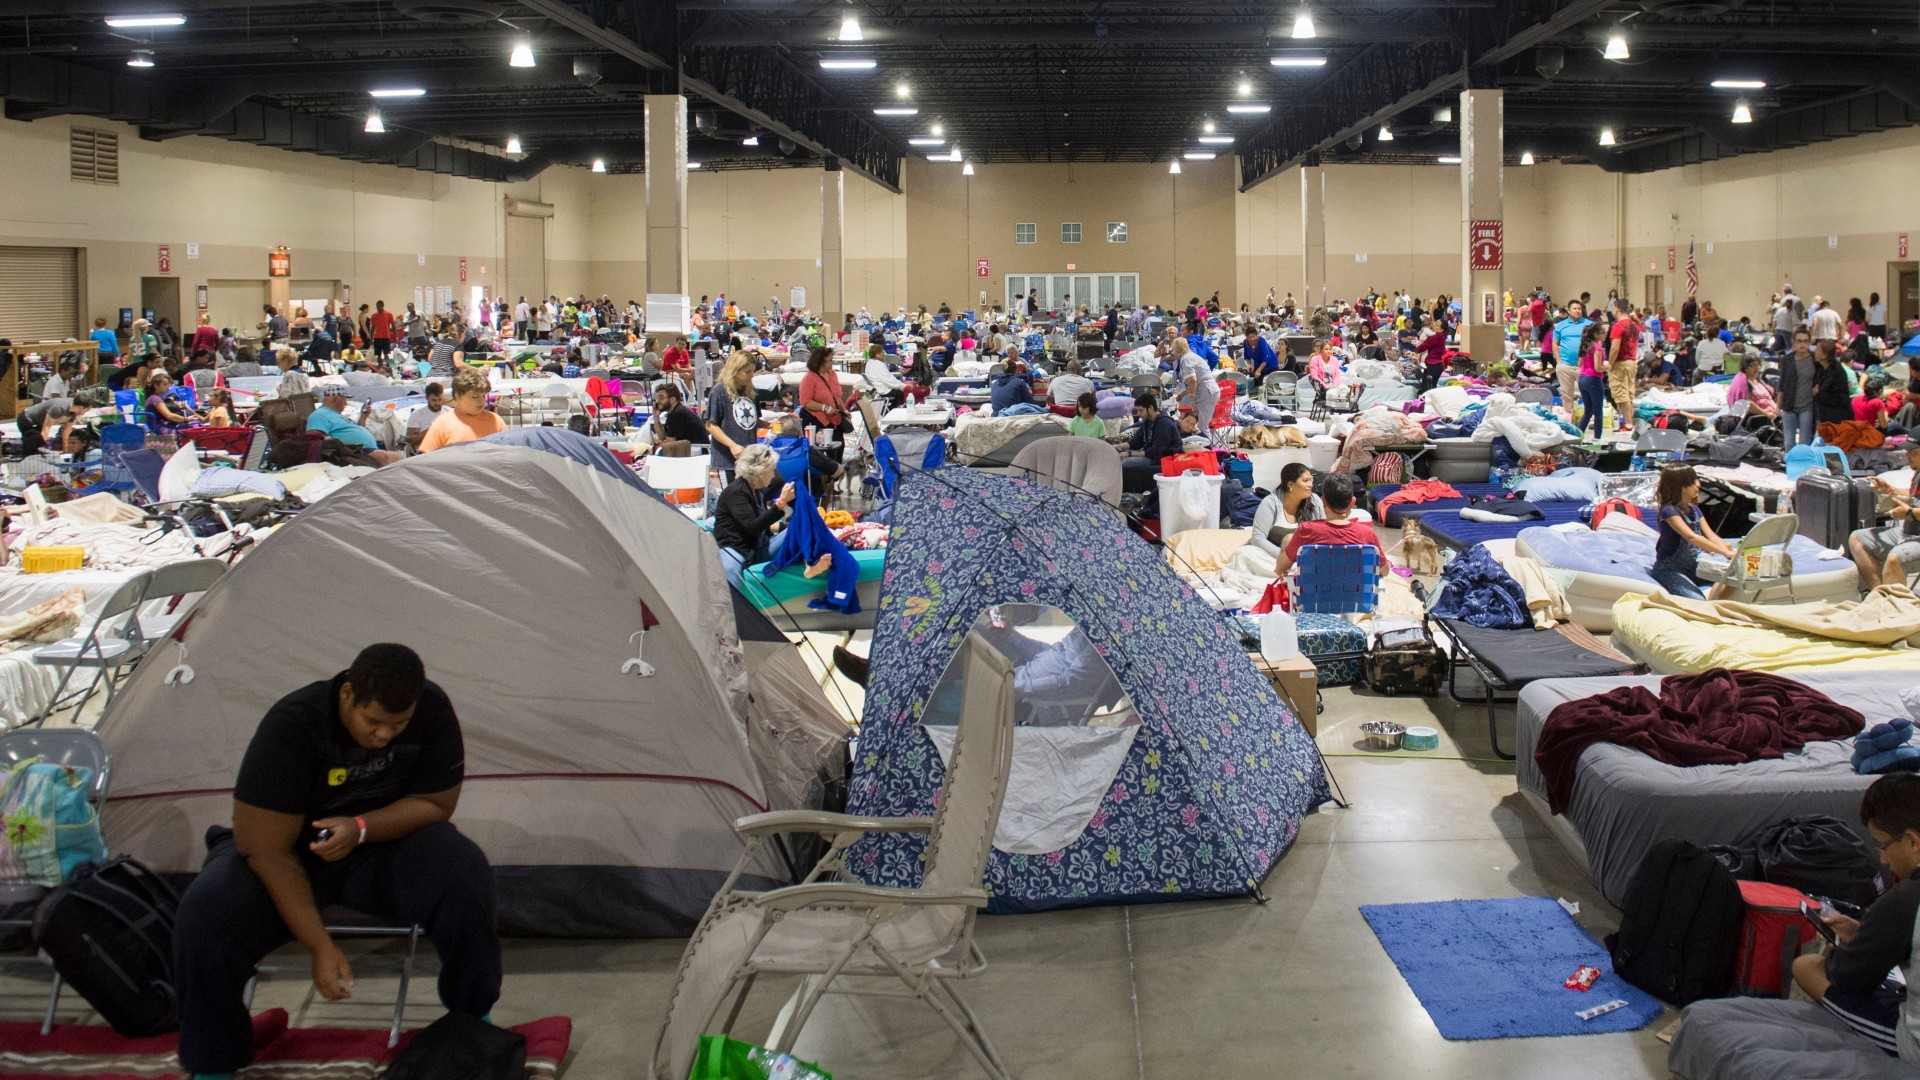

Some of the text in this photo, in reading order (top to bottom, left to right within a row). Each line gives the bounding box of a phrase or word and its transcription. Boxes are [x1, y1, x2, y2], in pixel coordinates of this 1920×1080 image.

[1478, 229, 1496, 237] FIRE
[907, 576, 941, 639] TOMMY BAHAMA
